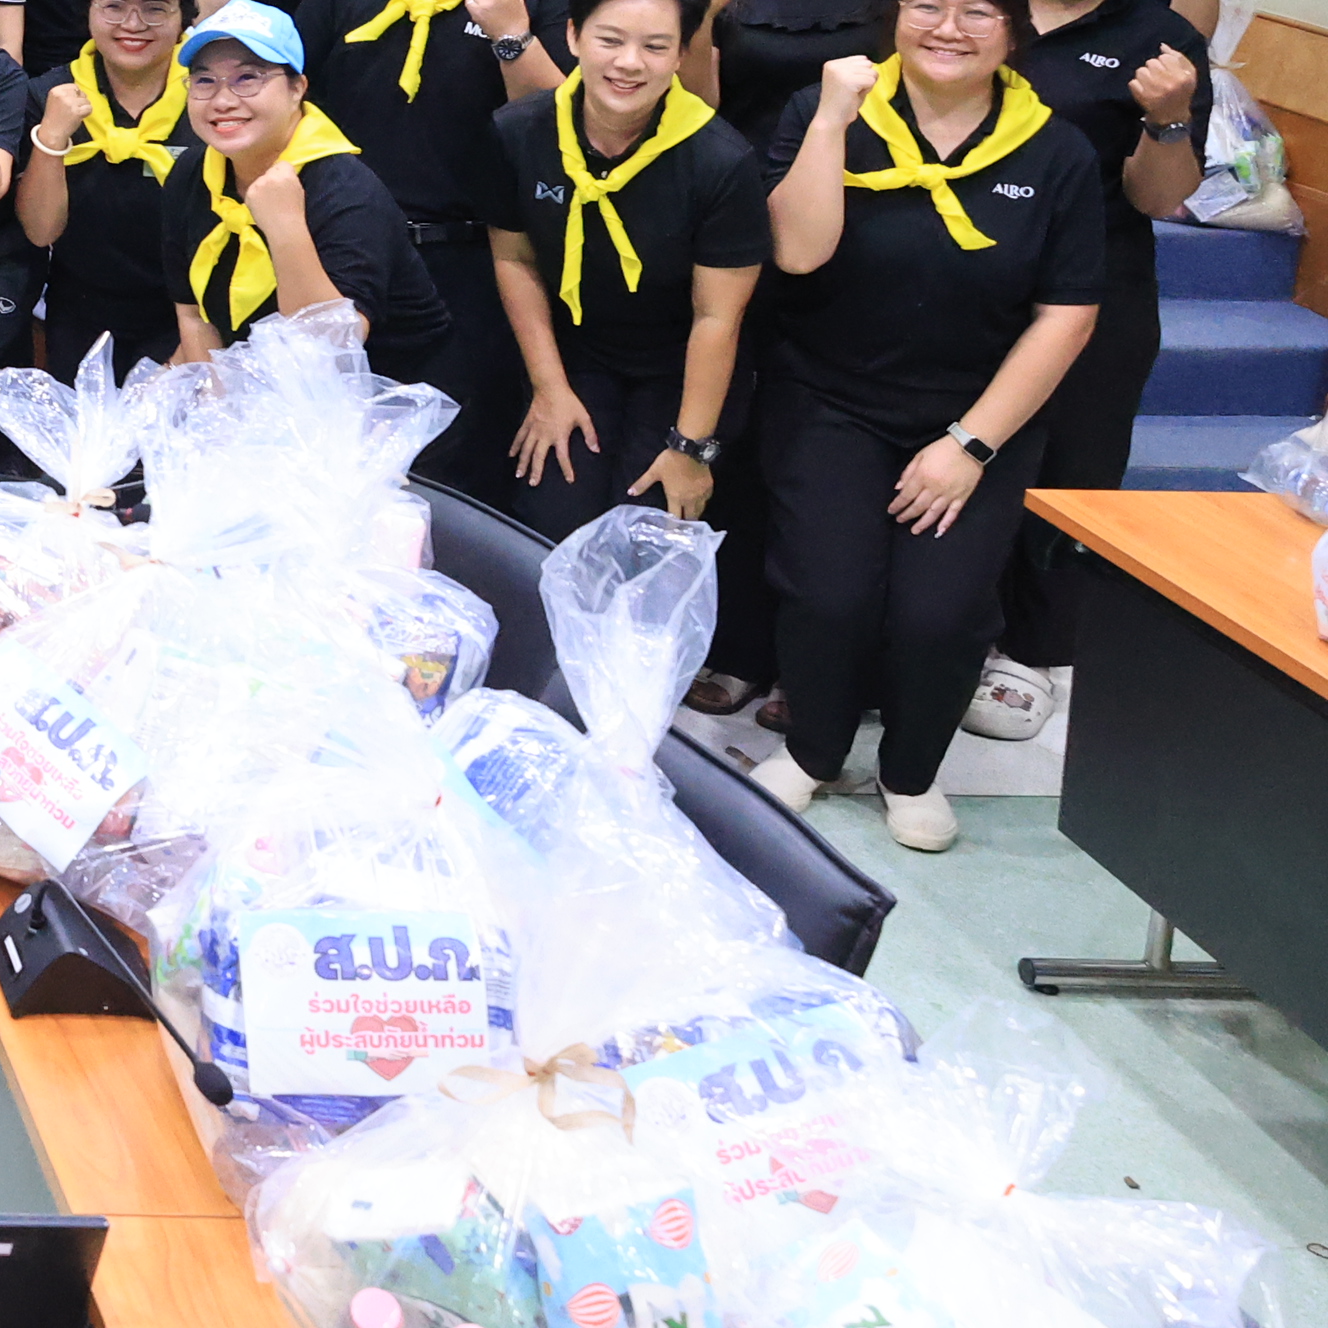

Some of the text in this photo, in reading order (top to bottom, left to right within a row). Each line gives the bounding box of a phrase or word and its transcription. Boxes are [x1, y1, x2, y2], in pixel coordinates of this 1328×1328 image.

[1079, 52, 1120, 68] ALRO
[992, 183, 1035, 199] ALRO
[313, 925, 481, 981] ส.ป.ก.
[308, 993, 471, 1016] ร่วมใจช่วยเหลือ
[300, 1021, 484, 1055] ผู้ประสบภัยน้ำท่วม
